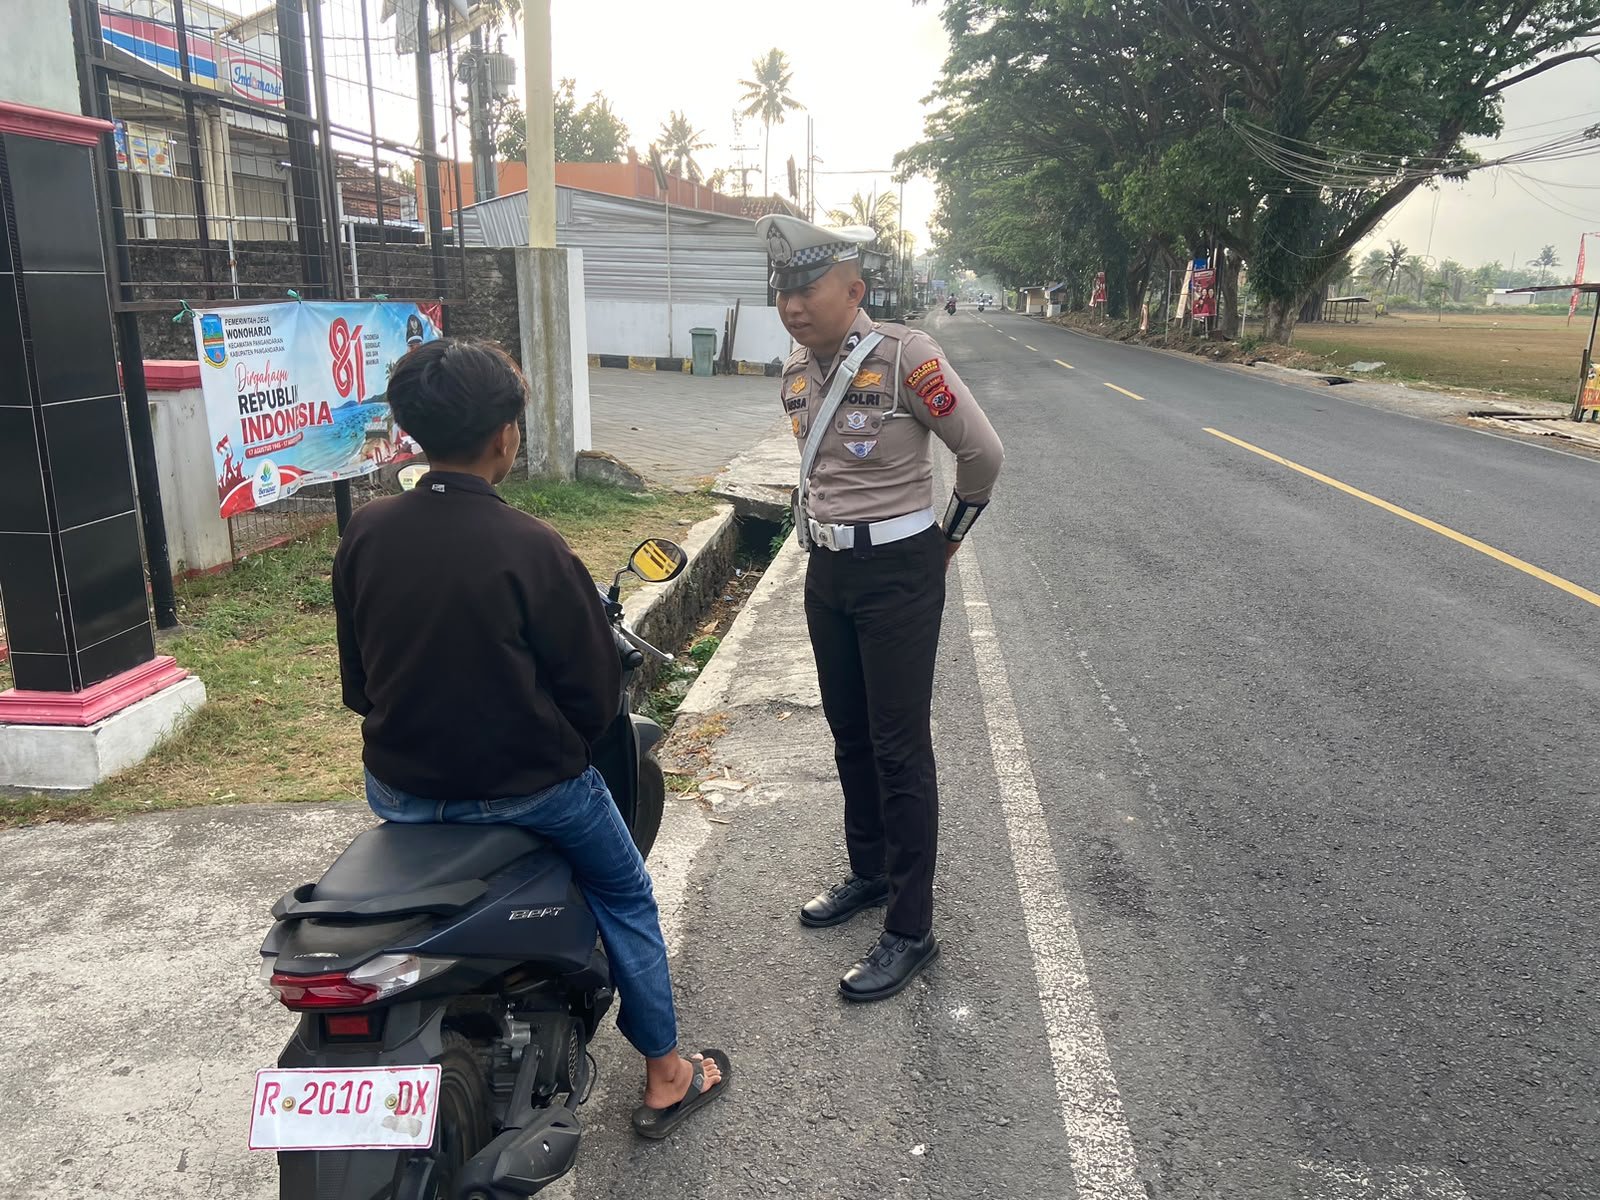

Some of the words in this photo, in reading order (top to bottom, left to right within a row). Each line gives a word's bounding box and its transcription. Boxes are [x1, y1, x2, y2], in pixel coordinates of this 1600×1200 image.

[225, 317, 256, 326] PEMERINTAH
[257, 316, 270, 324] DESA
[226, 326, 272, 340] WONOHARJO
[329, 316, 366, 405] 81
[908, 360, 938, 383] POLRES
[235, 359, 289, 395] Dirgahayu
[259, 1081, 281, 1116] R
[297, 1080, 374, 1115] 2010
[393, 1080, 430, 1116] DX
